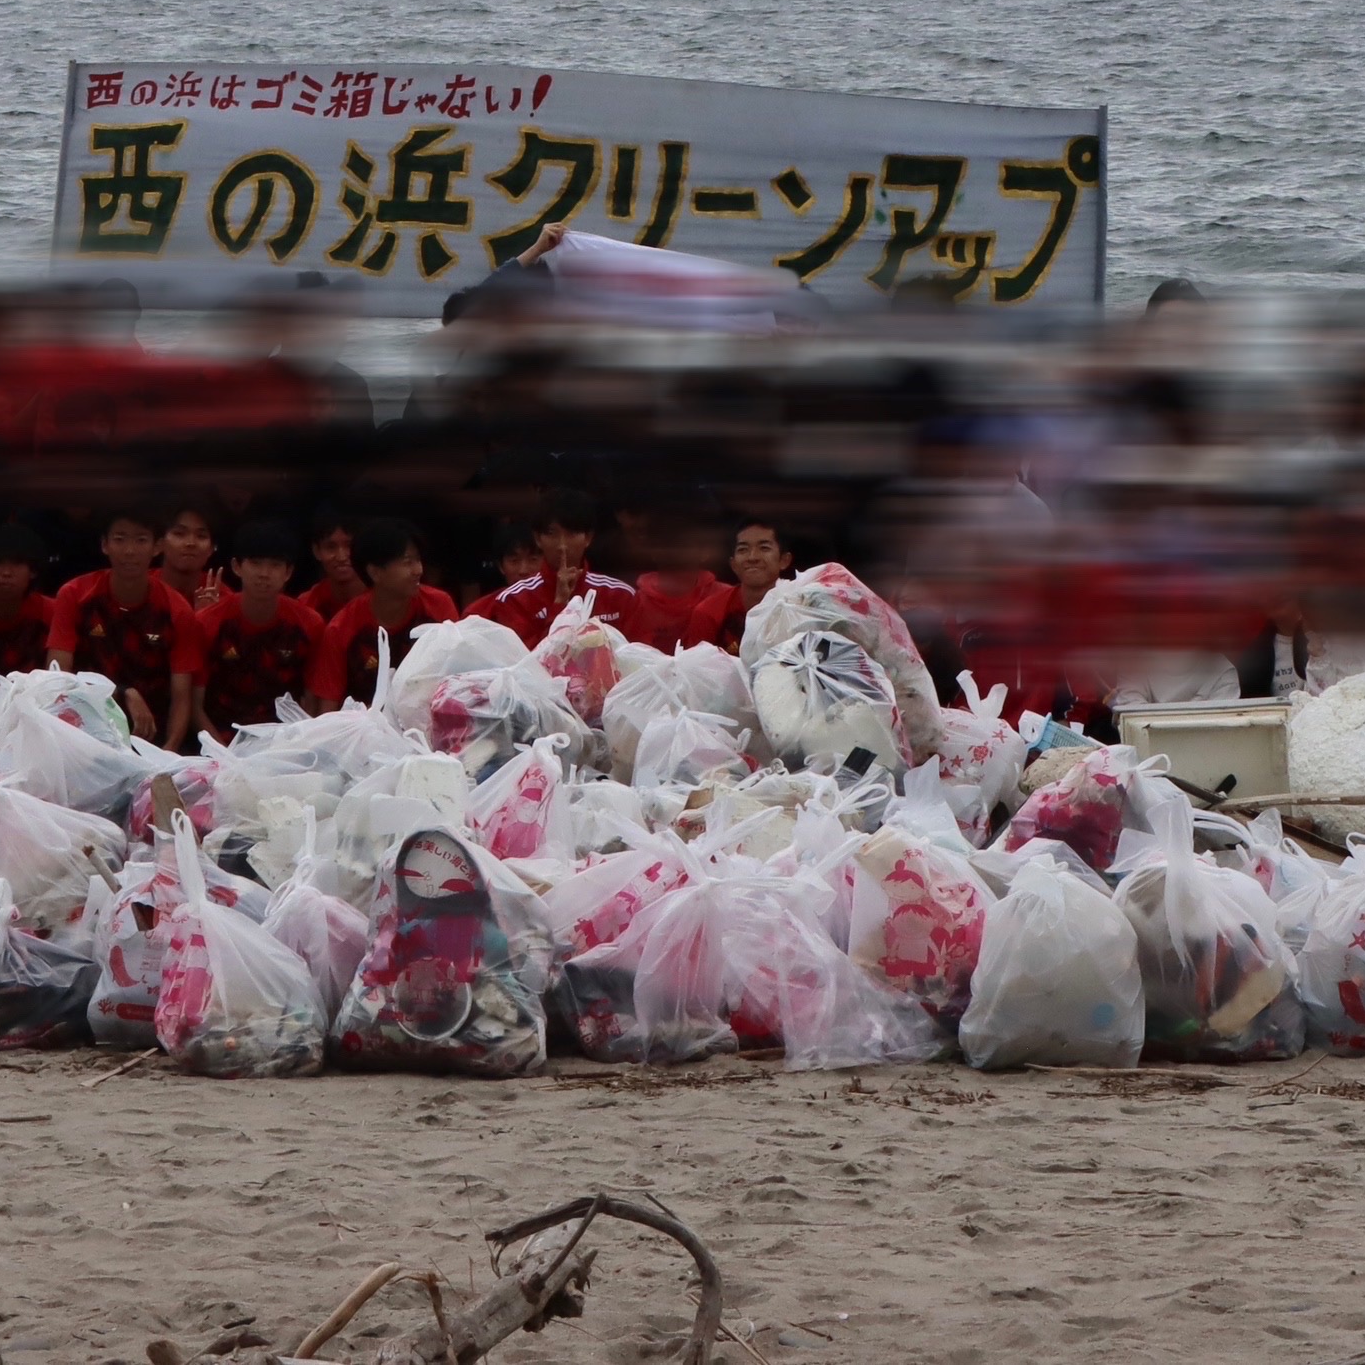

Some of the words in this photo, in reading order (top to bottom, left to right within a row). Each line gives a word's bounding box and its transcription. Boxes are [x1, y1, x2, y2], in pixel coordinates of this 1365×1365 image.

[78, 118, 1106, 304] 西の浜クリーンアップ
